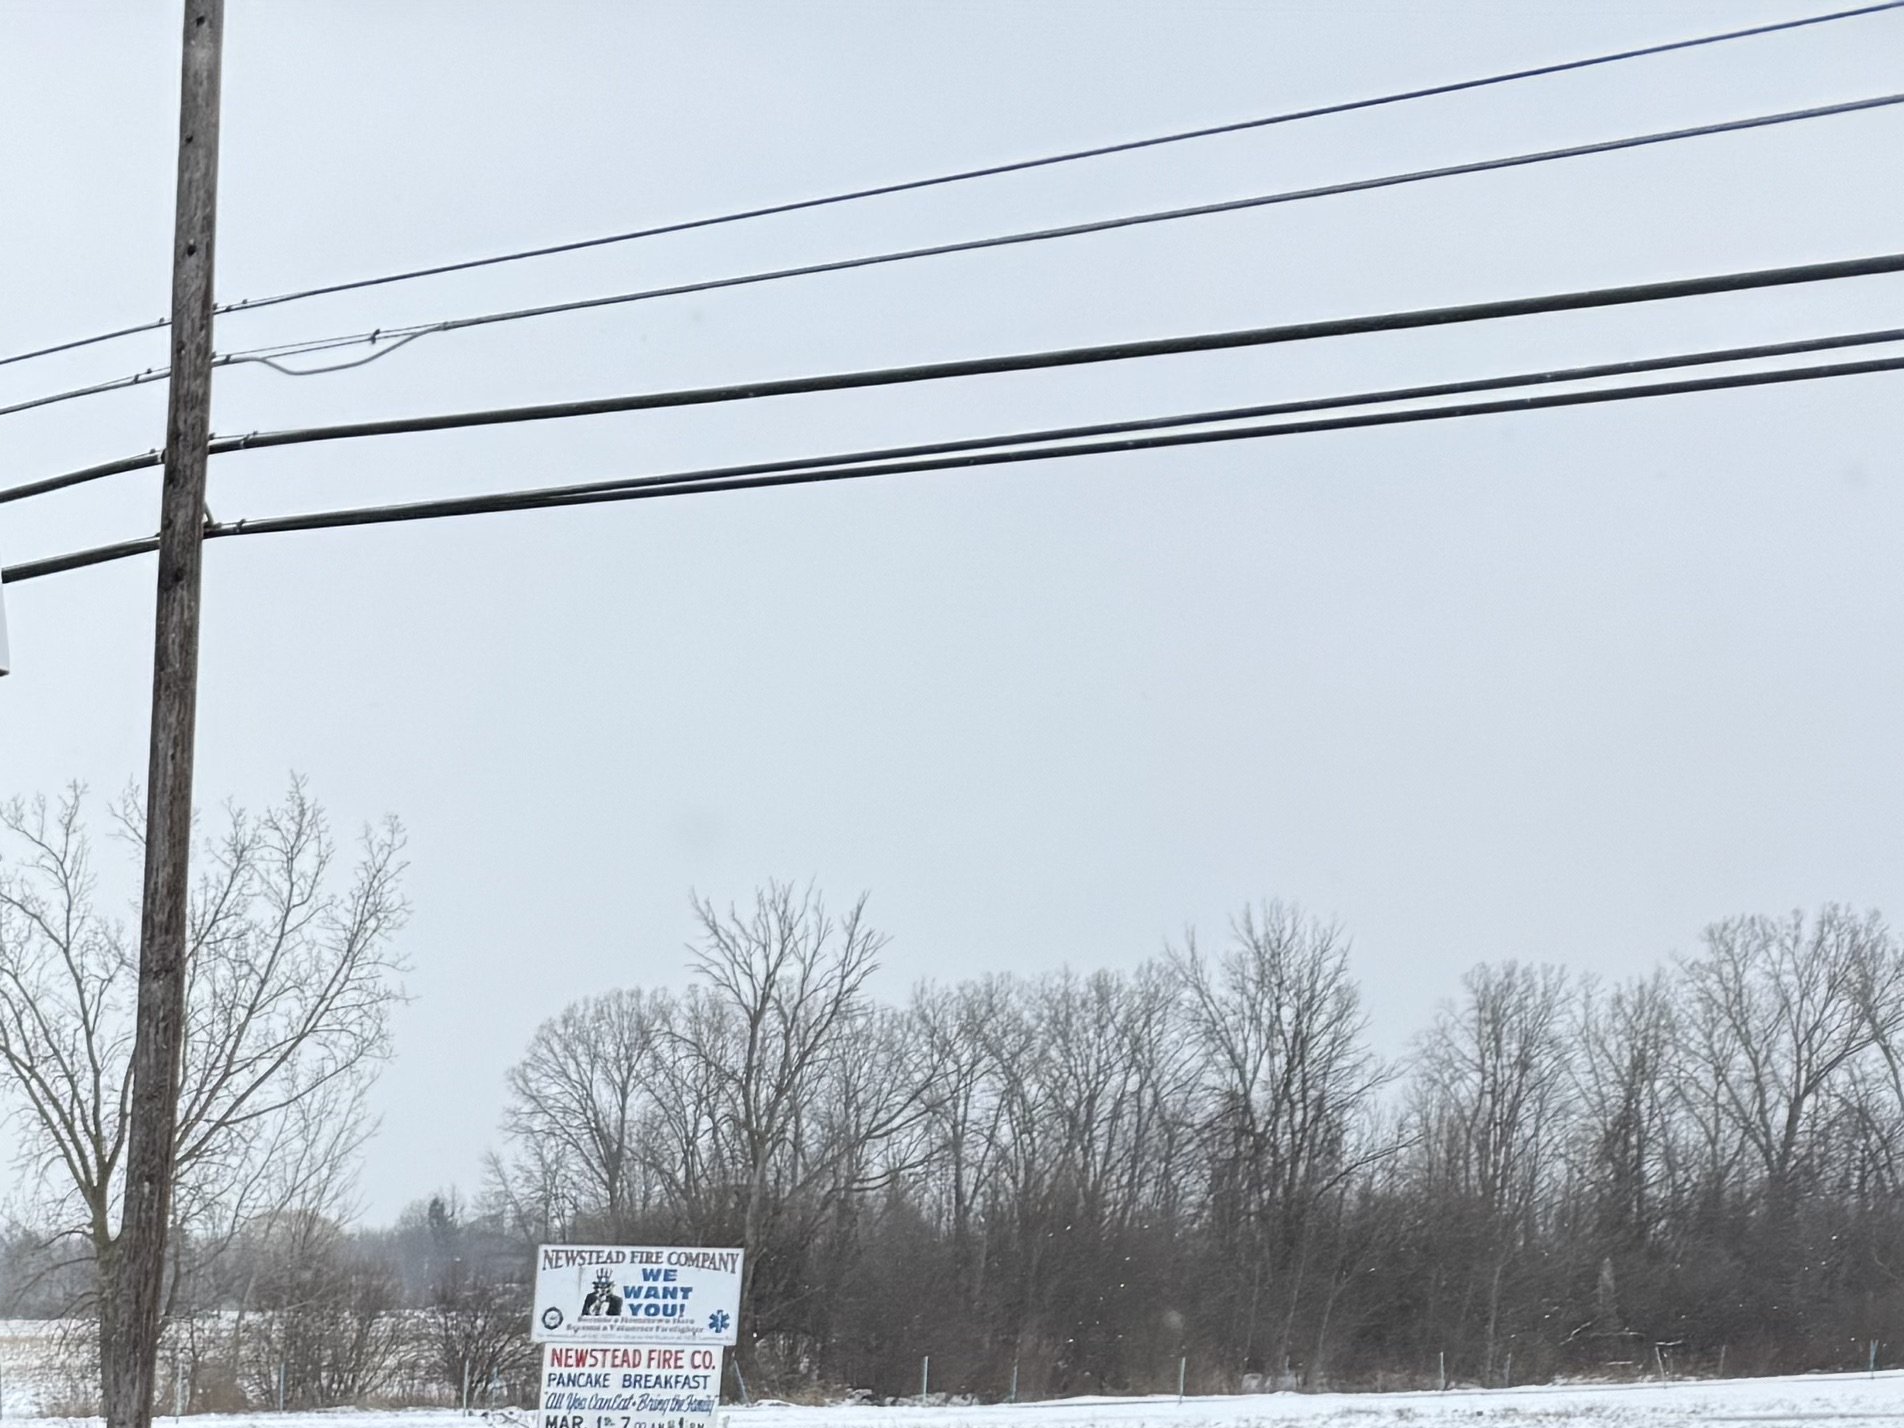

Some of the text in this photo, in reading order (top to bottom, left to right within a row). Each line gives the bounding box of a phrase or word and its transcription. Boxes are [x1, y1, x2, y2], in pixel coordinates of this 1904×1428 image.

[542, 1249, 740, 1274] NEWSTEAD FIRE COMPANY
[641, 1268, 678, 1282] WE
[623, 1285, 693, 1300] WANT
[627, 1303, 685, 1318] YOU!
[550, 1348, 716, 1370] NEWSTEAD FIRE CO.
[547, 1373, 711, 1390] PANCAKE BREAKFAST
